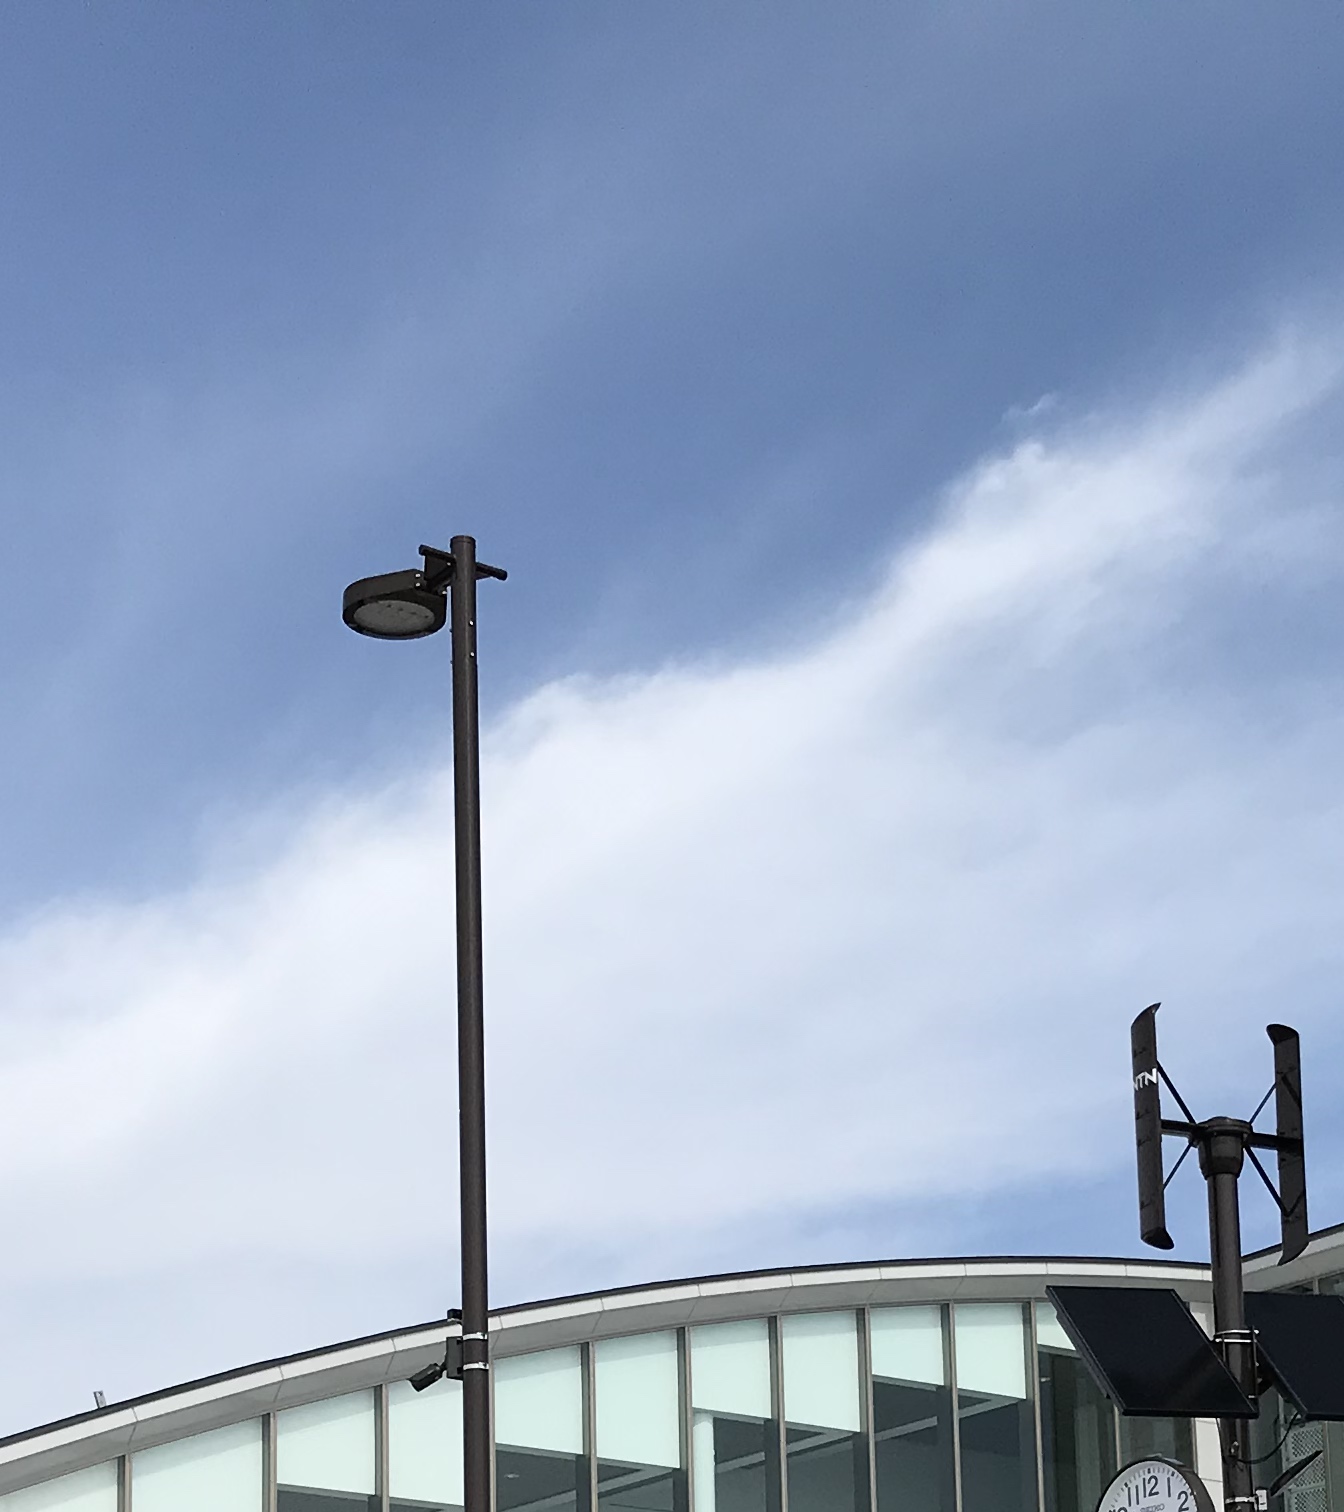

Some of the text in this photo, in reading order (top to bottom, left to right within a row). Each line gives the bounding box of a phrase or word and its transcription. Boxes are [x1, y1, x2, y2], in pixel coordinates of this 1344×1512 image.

[1127, 1485, 1140, 1507] 11
[1142, 1475, 1160, 1498] 12
[1177, 1491, 1190, 1512] 2
